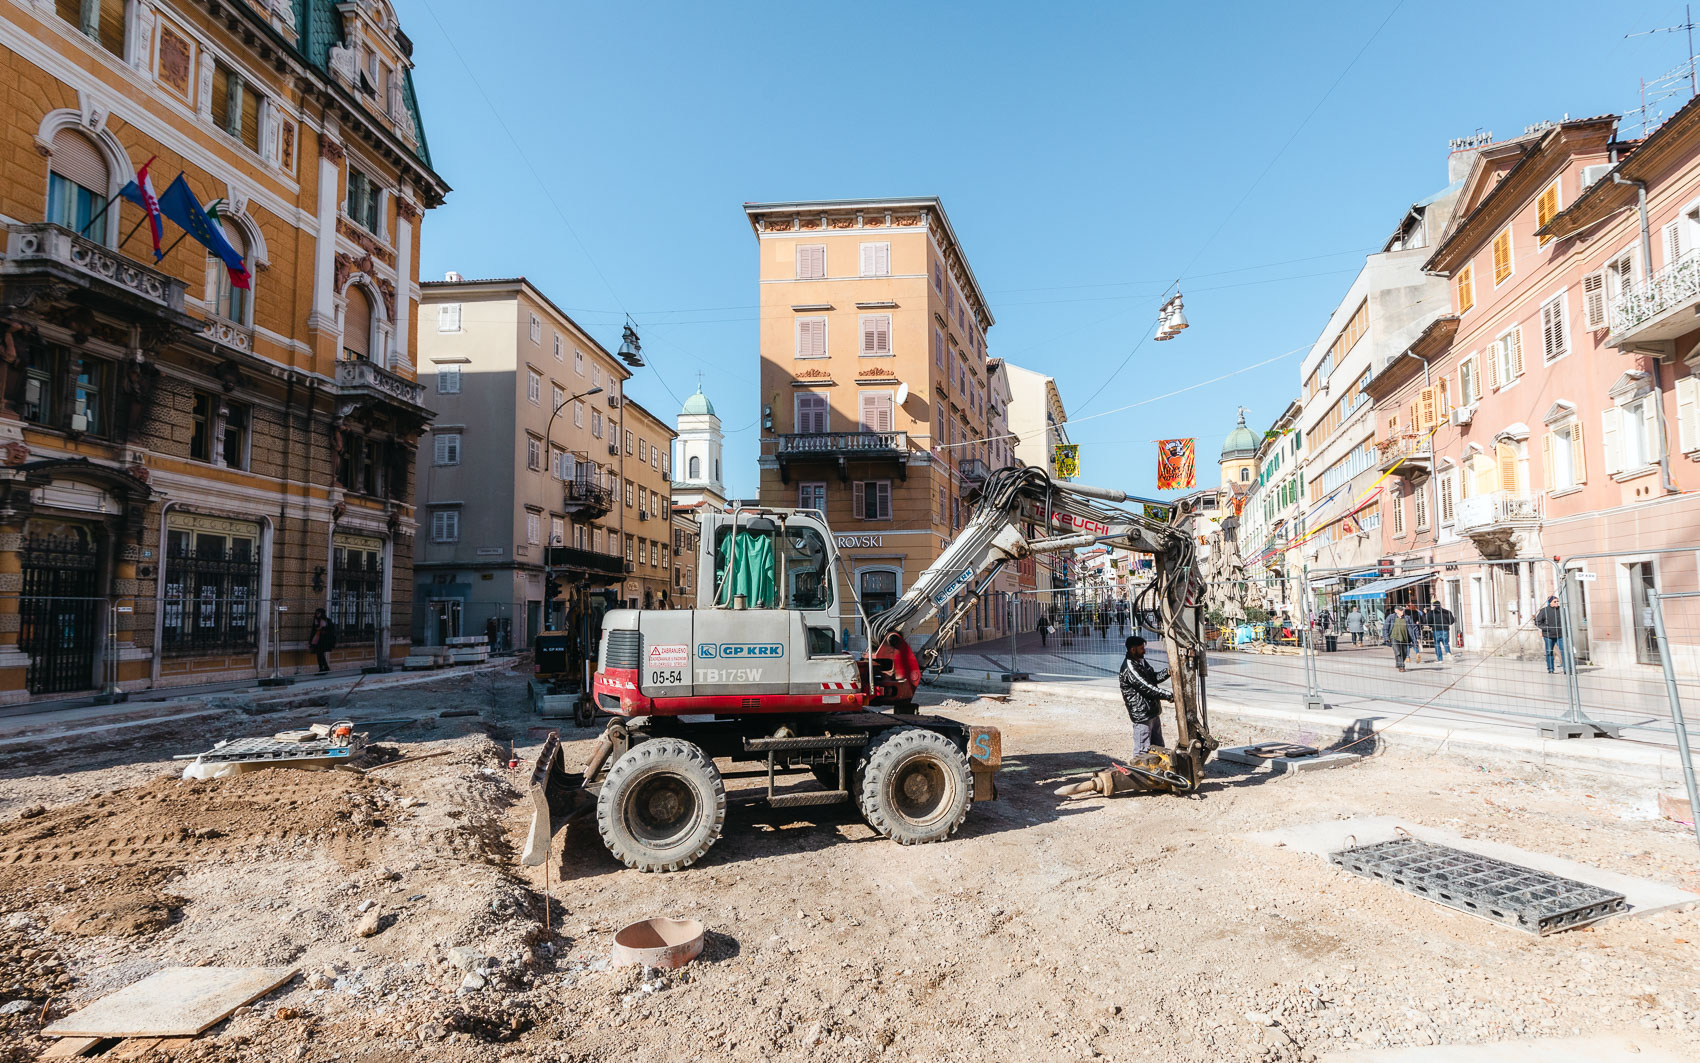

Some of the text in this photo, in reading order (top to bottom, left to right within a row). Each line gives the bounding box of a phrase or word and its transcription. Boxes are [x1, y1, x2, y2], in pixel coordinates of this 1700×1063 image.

[838, 535, 883, 548] ROVSKI
[946, 582, 957, 593] GP
[956, 569, 972, 585] KRK
[723, 646, 744, 655] GP
[747, 646, 780, 655] KRK
[652, 670, 682, 684] 05-54
[695, 668, 763, 683] TB175W
[972, 733, 990, 760] S
